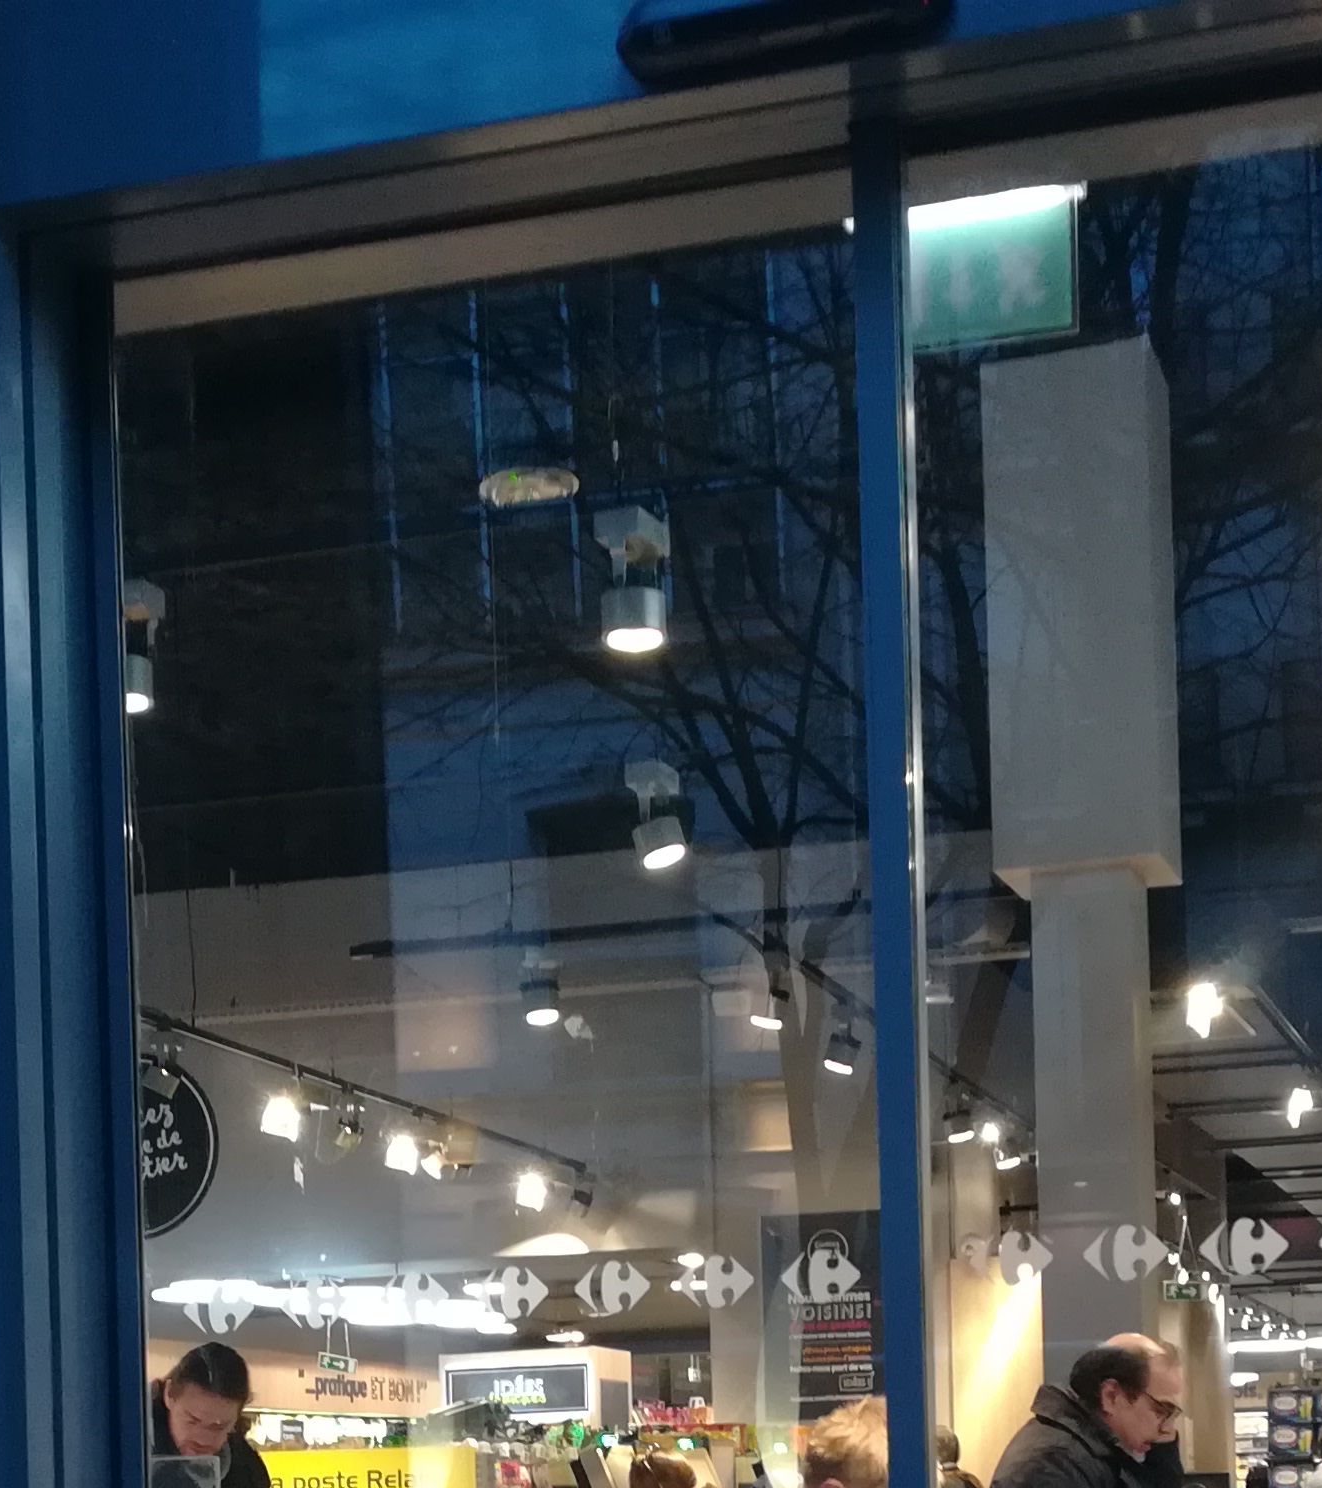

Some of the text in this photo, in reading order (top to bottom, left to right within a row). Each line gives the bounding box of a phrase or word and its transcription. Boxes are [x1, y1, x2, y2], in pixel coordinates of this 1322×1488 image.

[156, 1128, 183, 1150] de
[141, 1152, 189, 1182] tier
[370, 1375, 386, 1401] ET
[388, 1377, 414, 1403] BON
